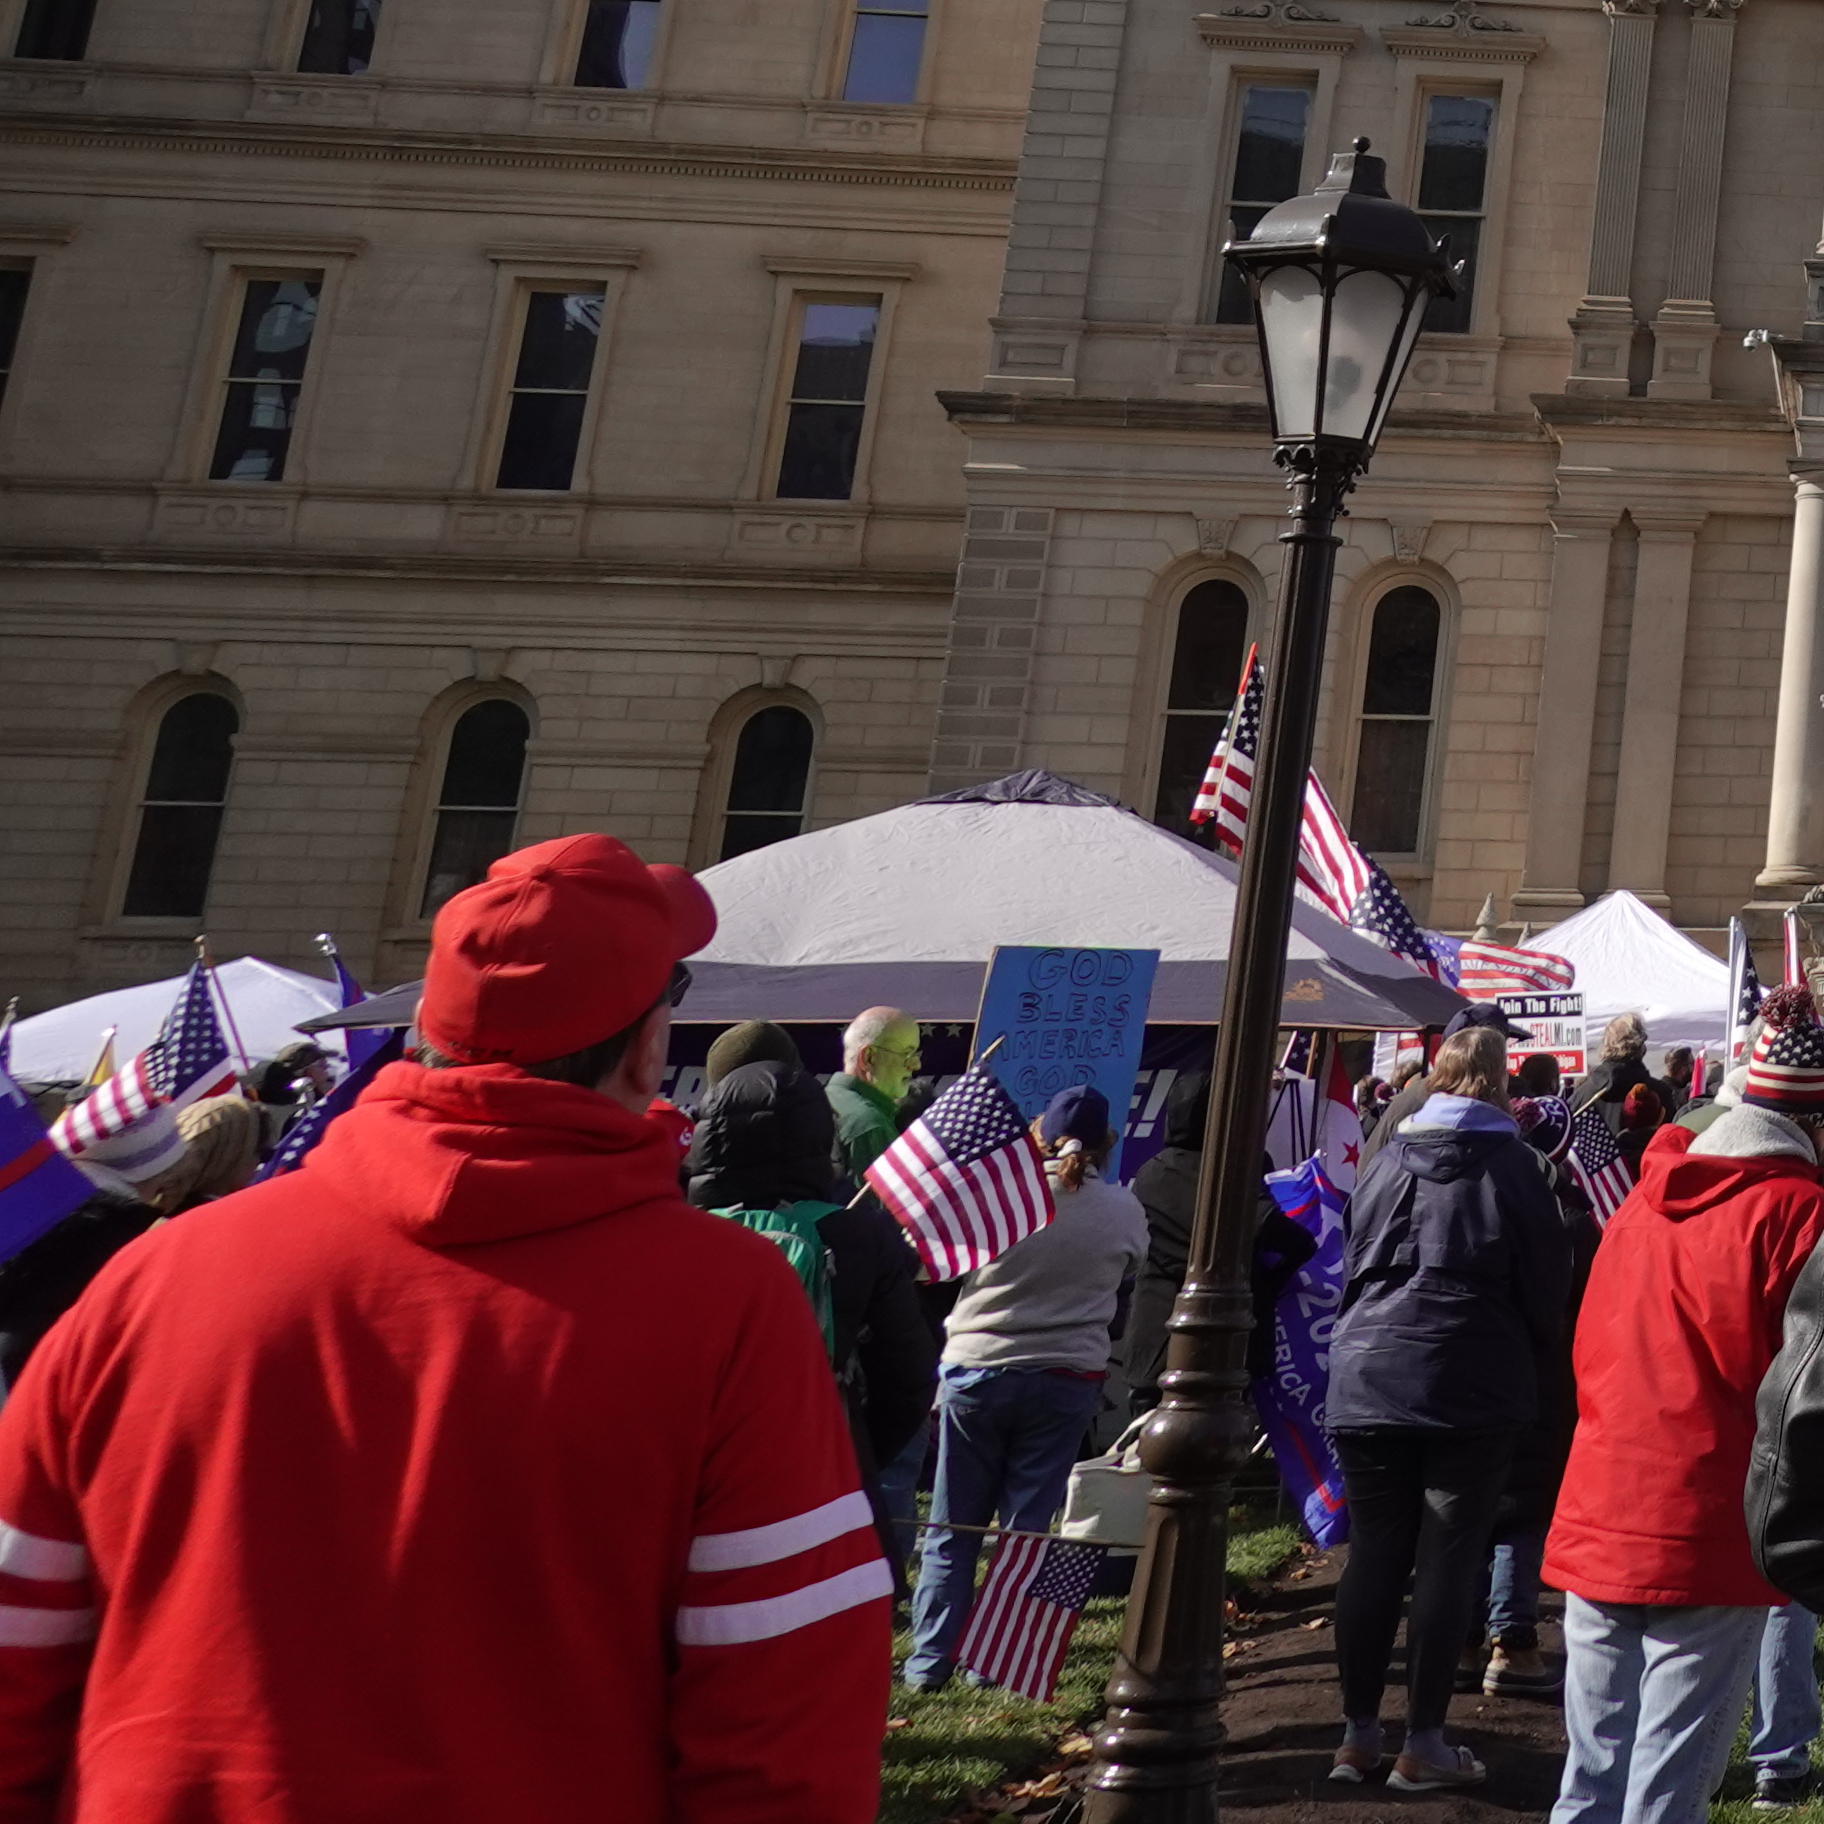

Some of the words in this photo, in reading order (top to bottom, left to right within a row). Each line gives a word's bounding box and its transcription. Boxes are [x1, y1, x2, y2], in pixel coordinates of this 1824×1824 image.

[1029, 949, 1133, 991] GOD
[1017, 991, 1132, 1027] BLESS
[1525, 997, 1546, 1014] The
[1550, 995, 1583, 1015] Fight!
